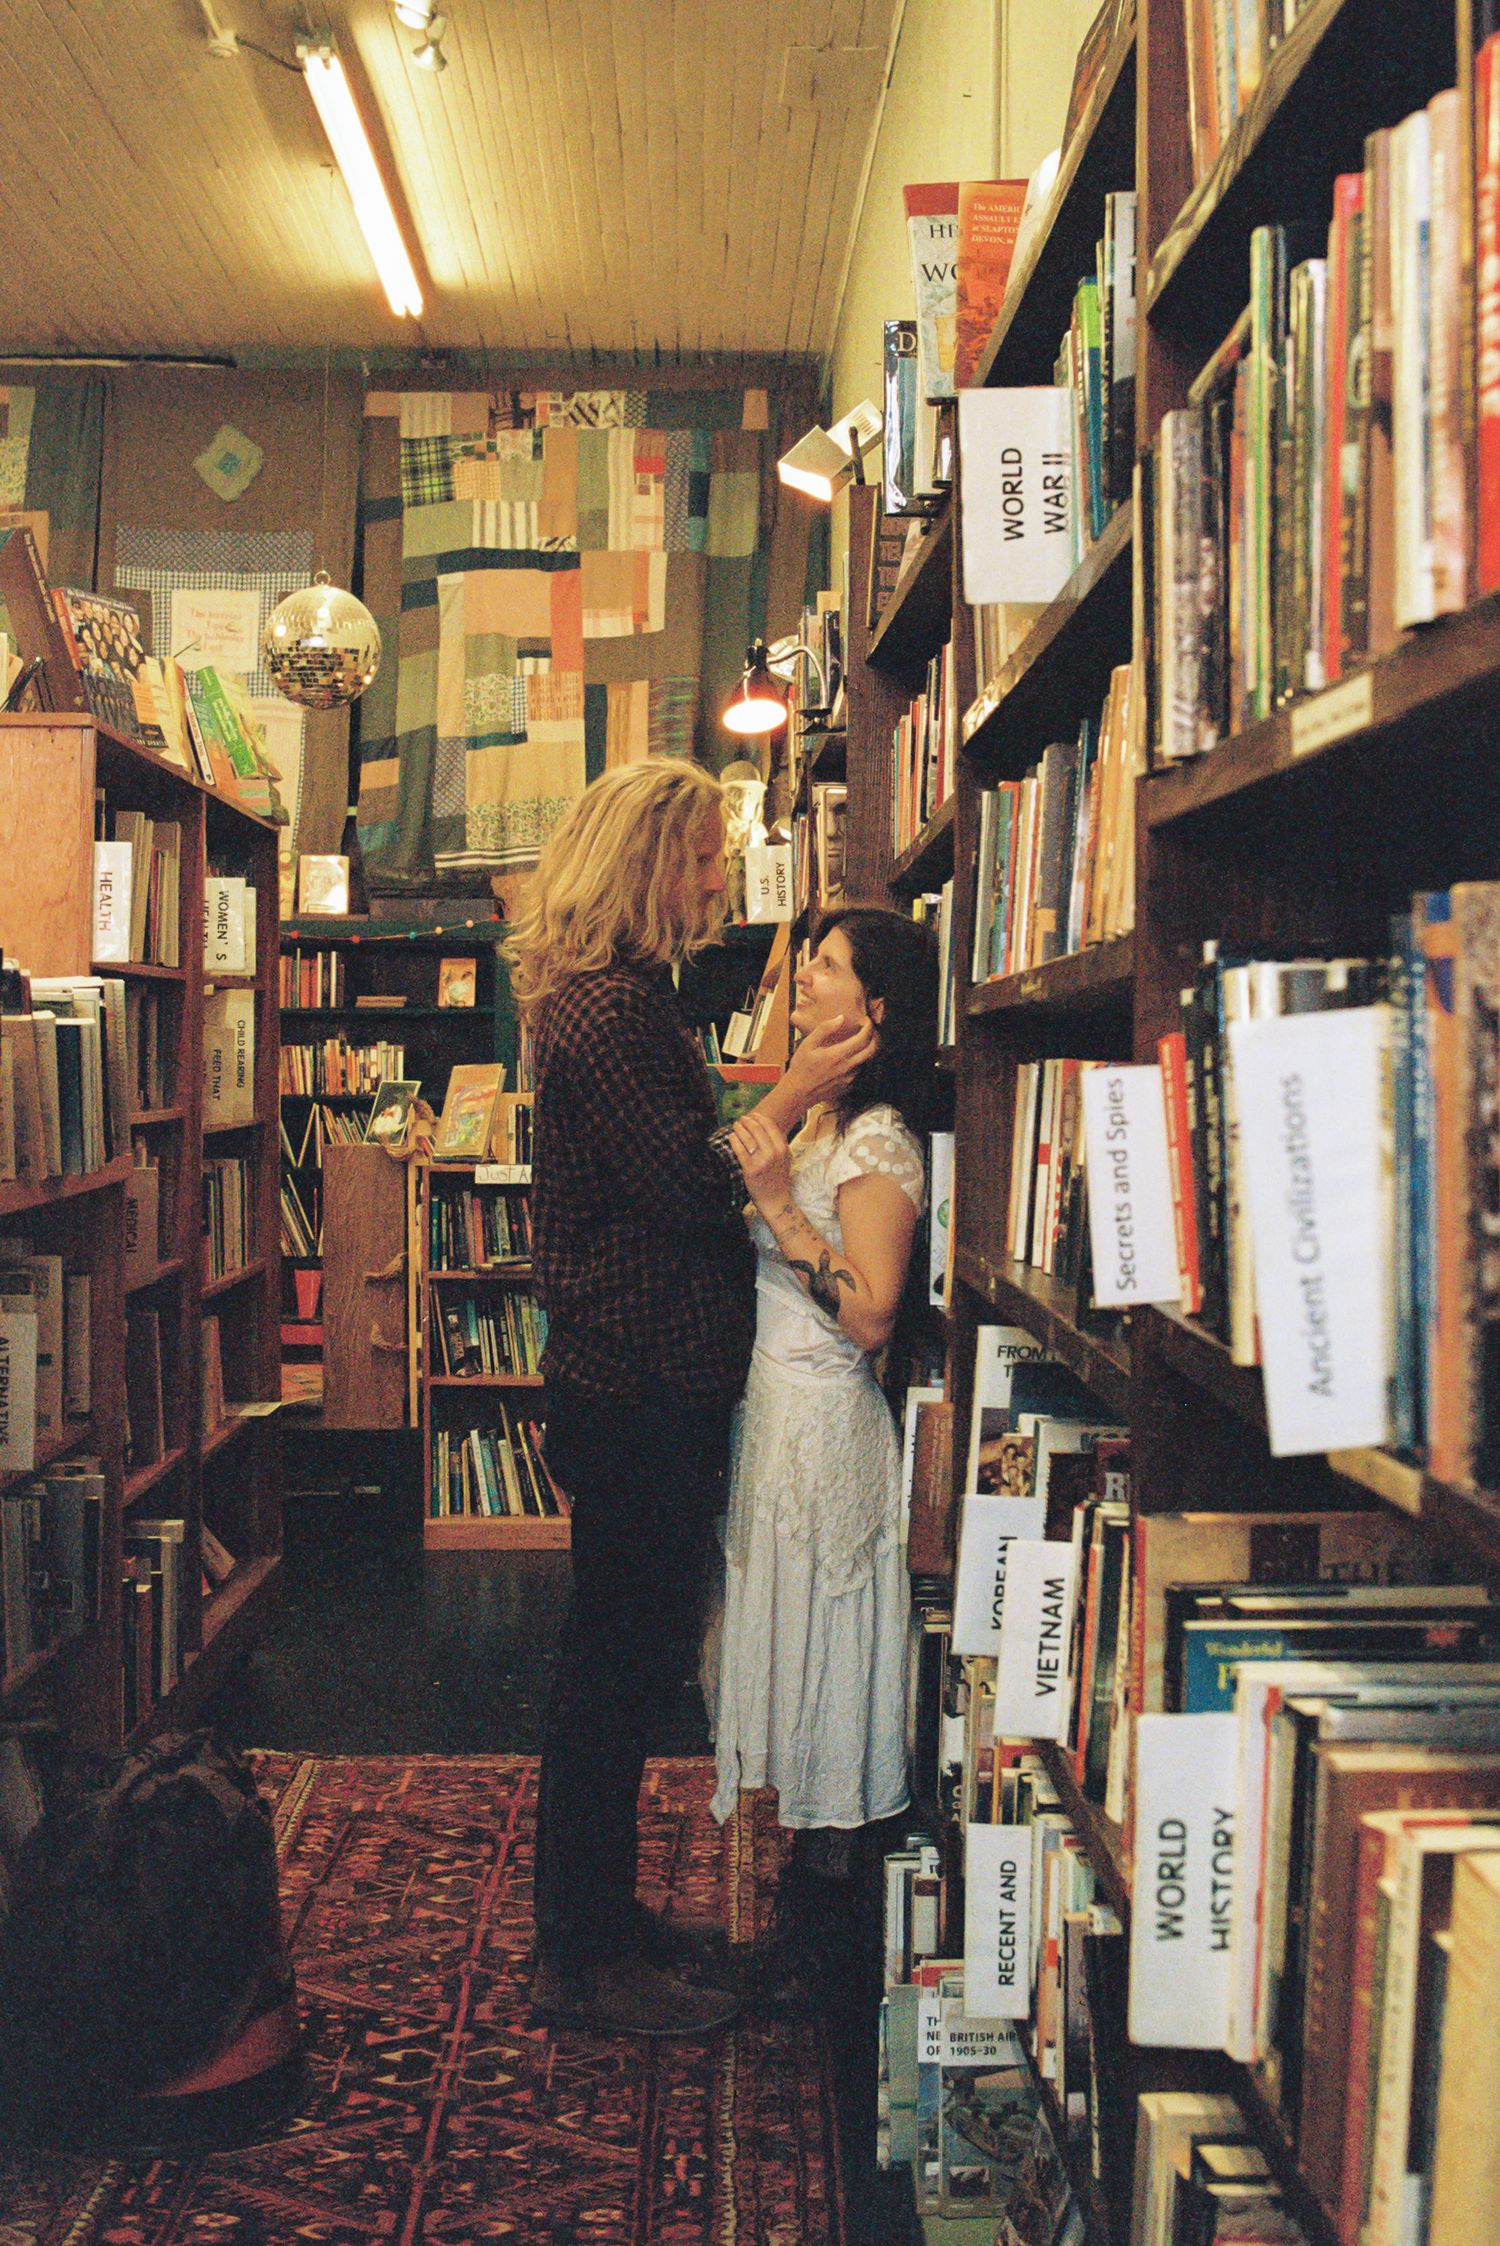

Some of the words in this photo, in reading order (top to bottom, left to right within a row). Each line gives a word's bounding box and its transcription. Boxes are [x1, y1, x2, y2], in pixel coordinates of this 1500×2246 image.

[1001, 447, 1024, 541] WORLD
[1043, 474, 1065, 534] WAR
[99, 871, 113, 932] HEALTH
[760, 876, 770, 895] U.S.
[775, 862, 787, 907] HISTORY
[237, 1019, 246, 1046] CHILD
[212, 1048, 222, 1073] FEED
[236, 1048, 246, 1089] REARING
[212, 1075, 221, 1101] THAT
[1103, 1077, 1131, 1144] Spies
[1107, 1150, 1131, 1194] and
[1281, 1072, 1321, 1265] Civilizations
[1113, 1201, 1138, 1292] Secrets
[997, 1344, 1046, 1361] FROM
[1300, 1273, 1333, 1397] Ancient
[1035, 1578, 1065, 1697] VIETNAM
[1000, 1860, 1017, 1902] AND
[1156, 1817, 1187, 1942] WORLD
[1210, 1807, 1234, 1952] HISTORY
[998, 1908, 1016, 1986] RECENT
[949, 2031, 994, 2043] BRITISH
[949, 2046, 997, 2056] 1905-30
